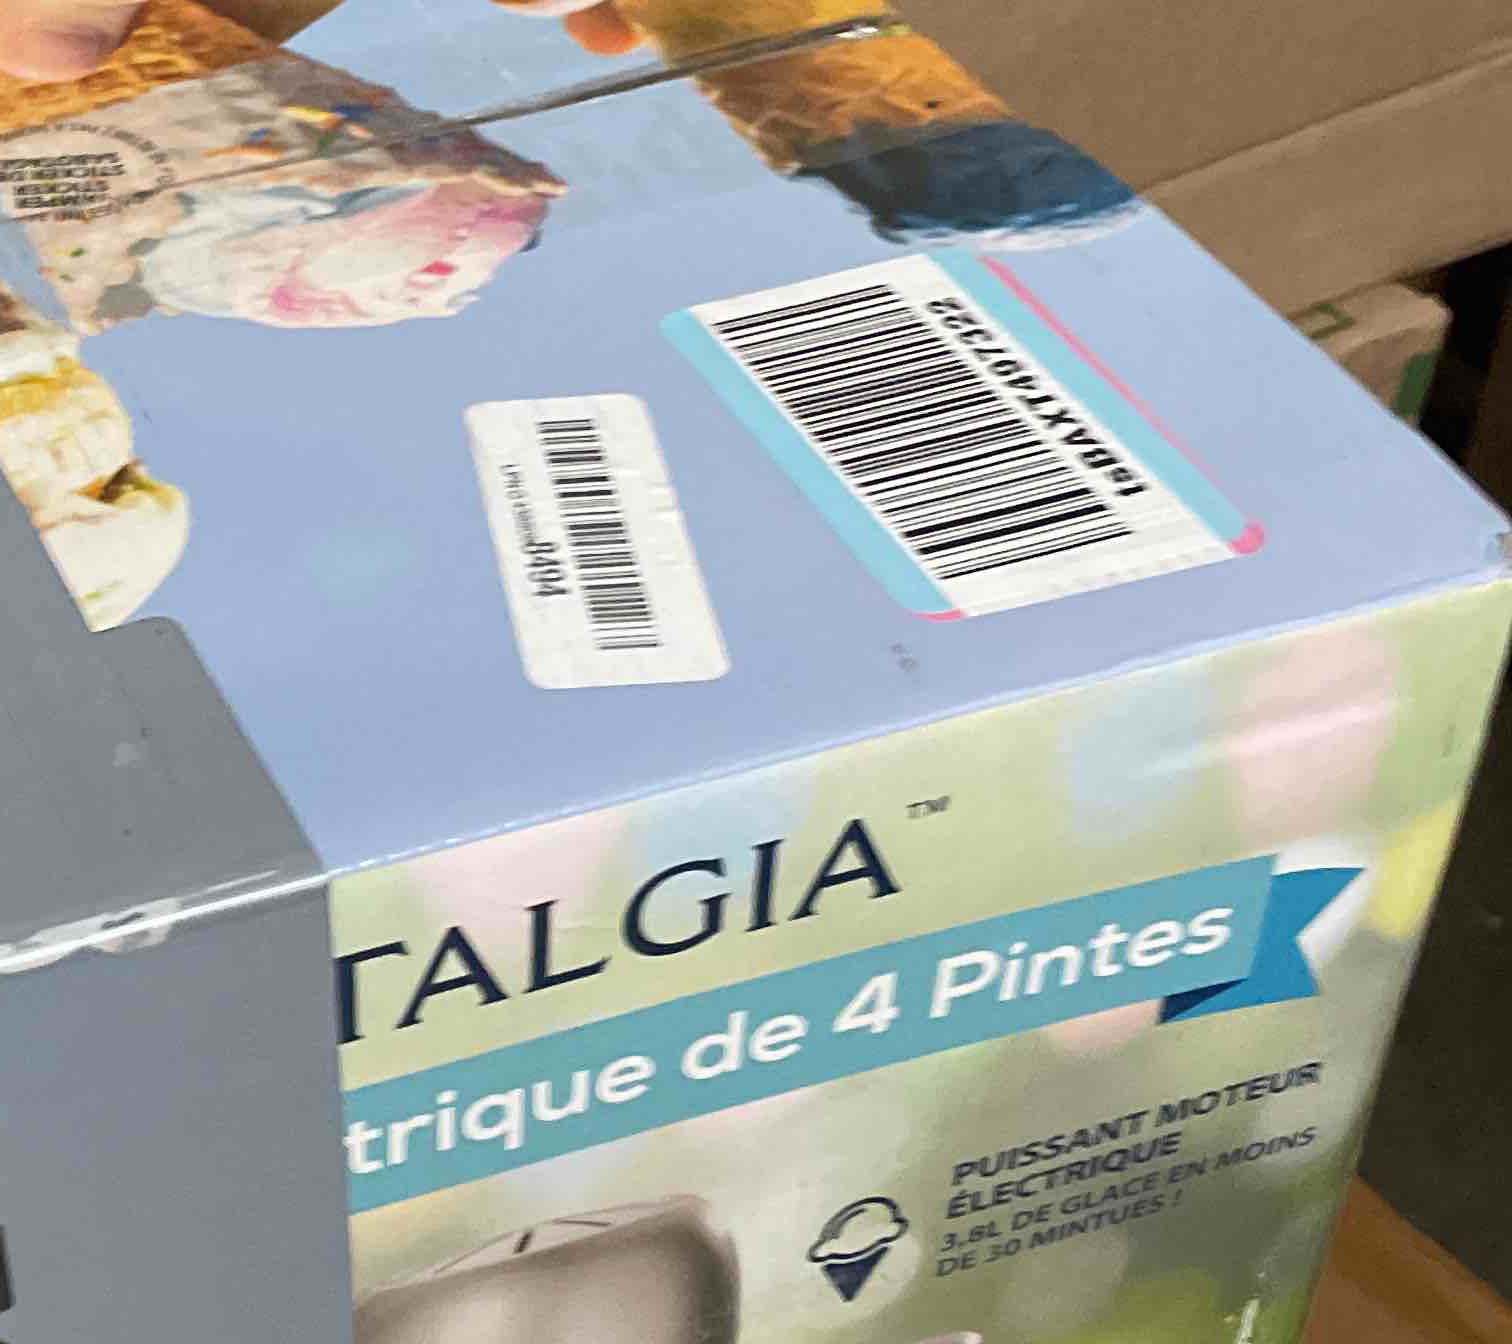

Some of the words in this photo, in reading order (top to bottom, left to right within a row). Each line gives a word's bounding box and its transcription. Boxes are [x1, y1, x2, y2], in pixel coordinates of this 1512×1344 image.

[337, 817, 902, 1045] TALGIA
[343, 1054, 656, 1174] trique
[680, 1010, 810, 1080] de
[831, 972, 903, 1034] 4
[928, 906, 1235, 1020] Pintes
[945, 1131, 1184, 1220] ÉLECTRIQUE
[951, 1109, 1149, 1186] PUISSANT
[1155, 1062, 1325, 1128] MOTEUR
[1010, 1203, 1052, 1232] DE
[1060, 1171, 1161, 1217] GLACE
[1166, 1154, 1207, 1185] EN
[1212, 1125, 1319, 1171] MOINS
[934, 1246, 979, 1278] DE
[983, 1237, 1022, 1264] 30
[1028, 1194, 1174, 1250] MINTUES
